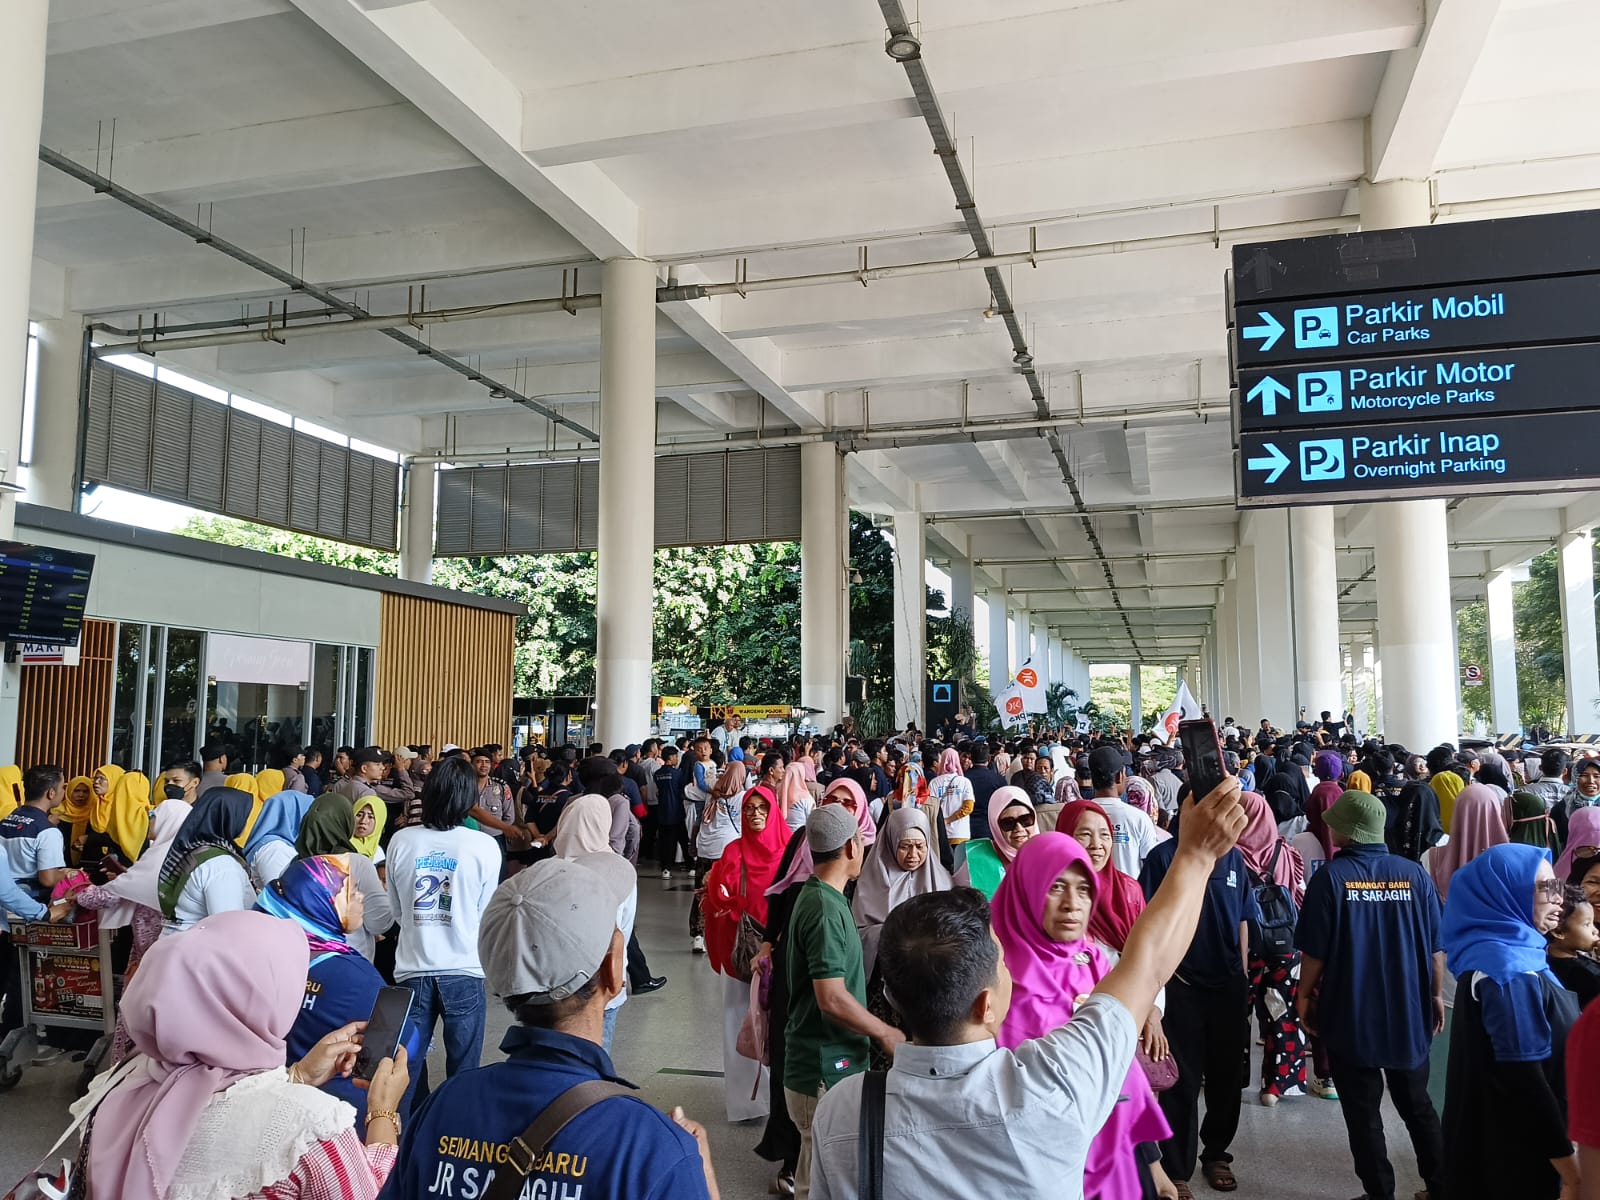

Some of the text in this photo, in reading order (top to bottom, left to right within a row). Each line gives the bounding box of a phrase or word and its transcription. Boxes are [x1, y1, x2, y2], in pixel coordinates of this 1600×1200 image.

[1345, 293, 1505, 326] Parkir Mobil
[1346, 325, 1430, 345] Car Parks
[1349, 361, 1515, 391] Parkir Motor
[1350, 389, 1495, 410] Motorcycle Parks
[1351, 431, 1500, 459] Parkir Inap
[1353, 457, 1506, 479] Overnight Parking
[413, 874, 441, 911] 2
[1345, 881, 1410, 889] SEMANGAT BARU
[1346, 889, 1411, 901] JR SARAGIH
[306, 980, 321, 993] RU
[438, 1135, 510, 1164] SEMANG
[428, 1160, 455, 1197] JR
